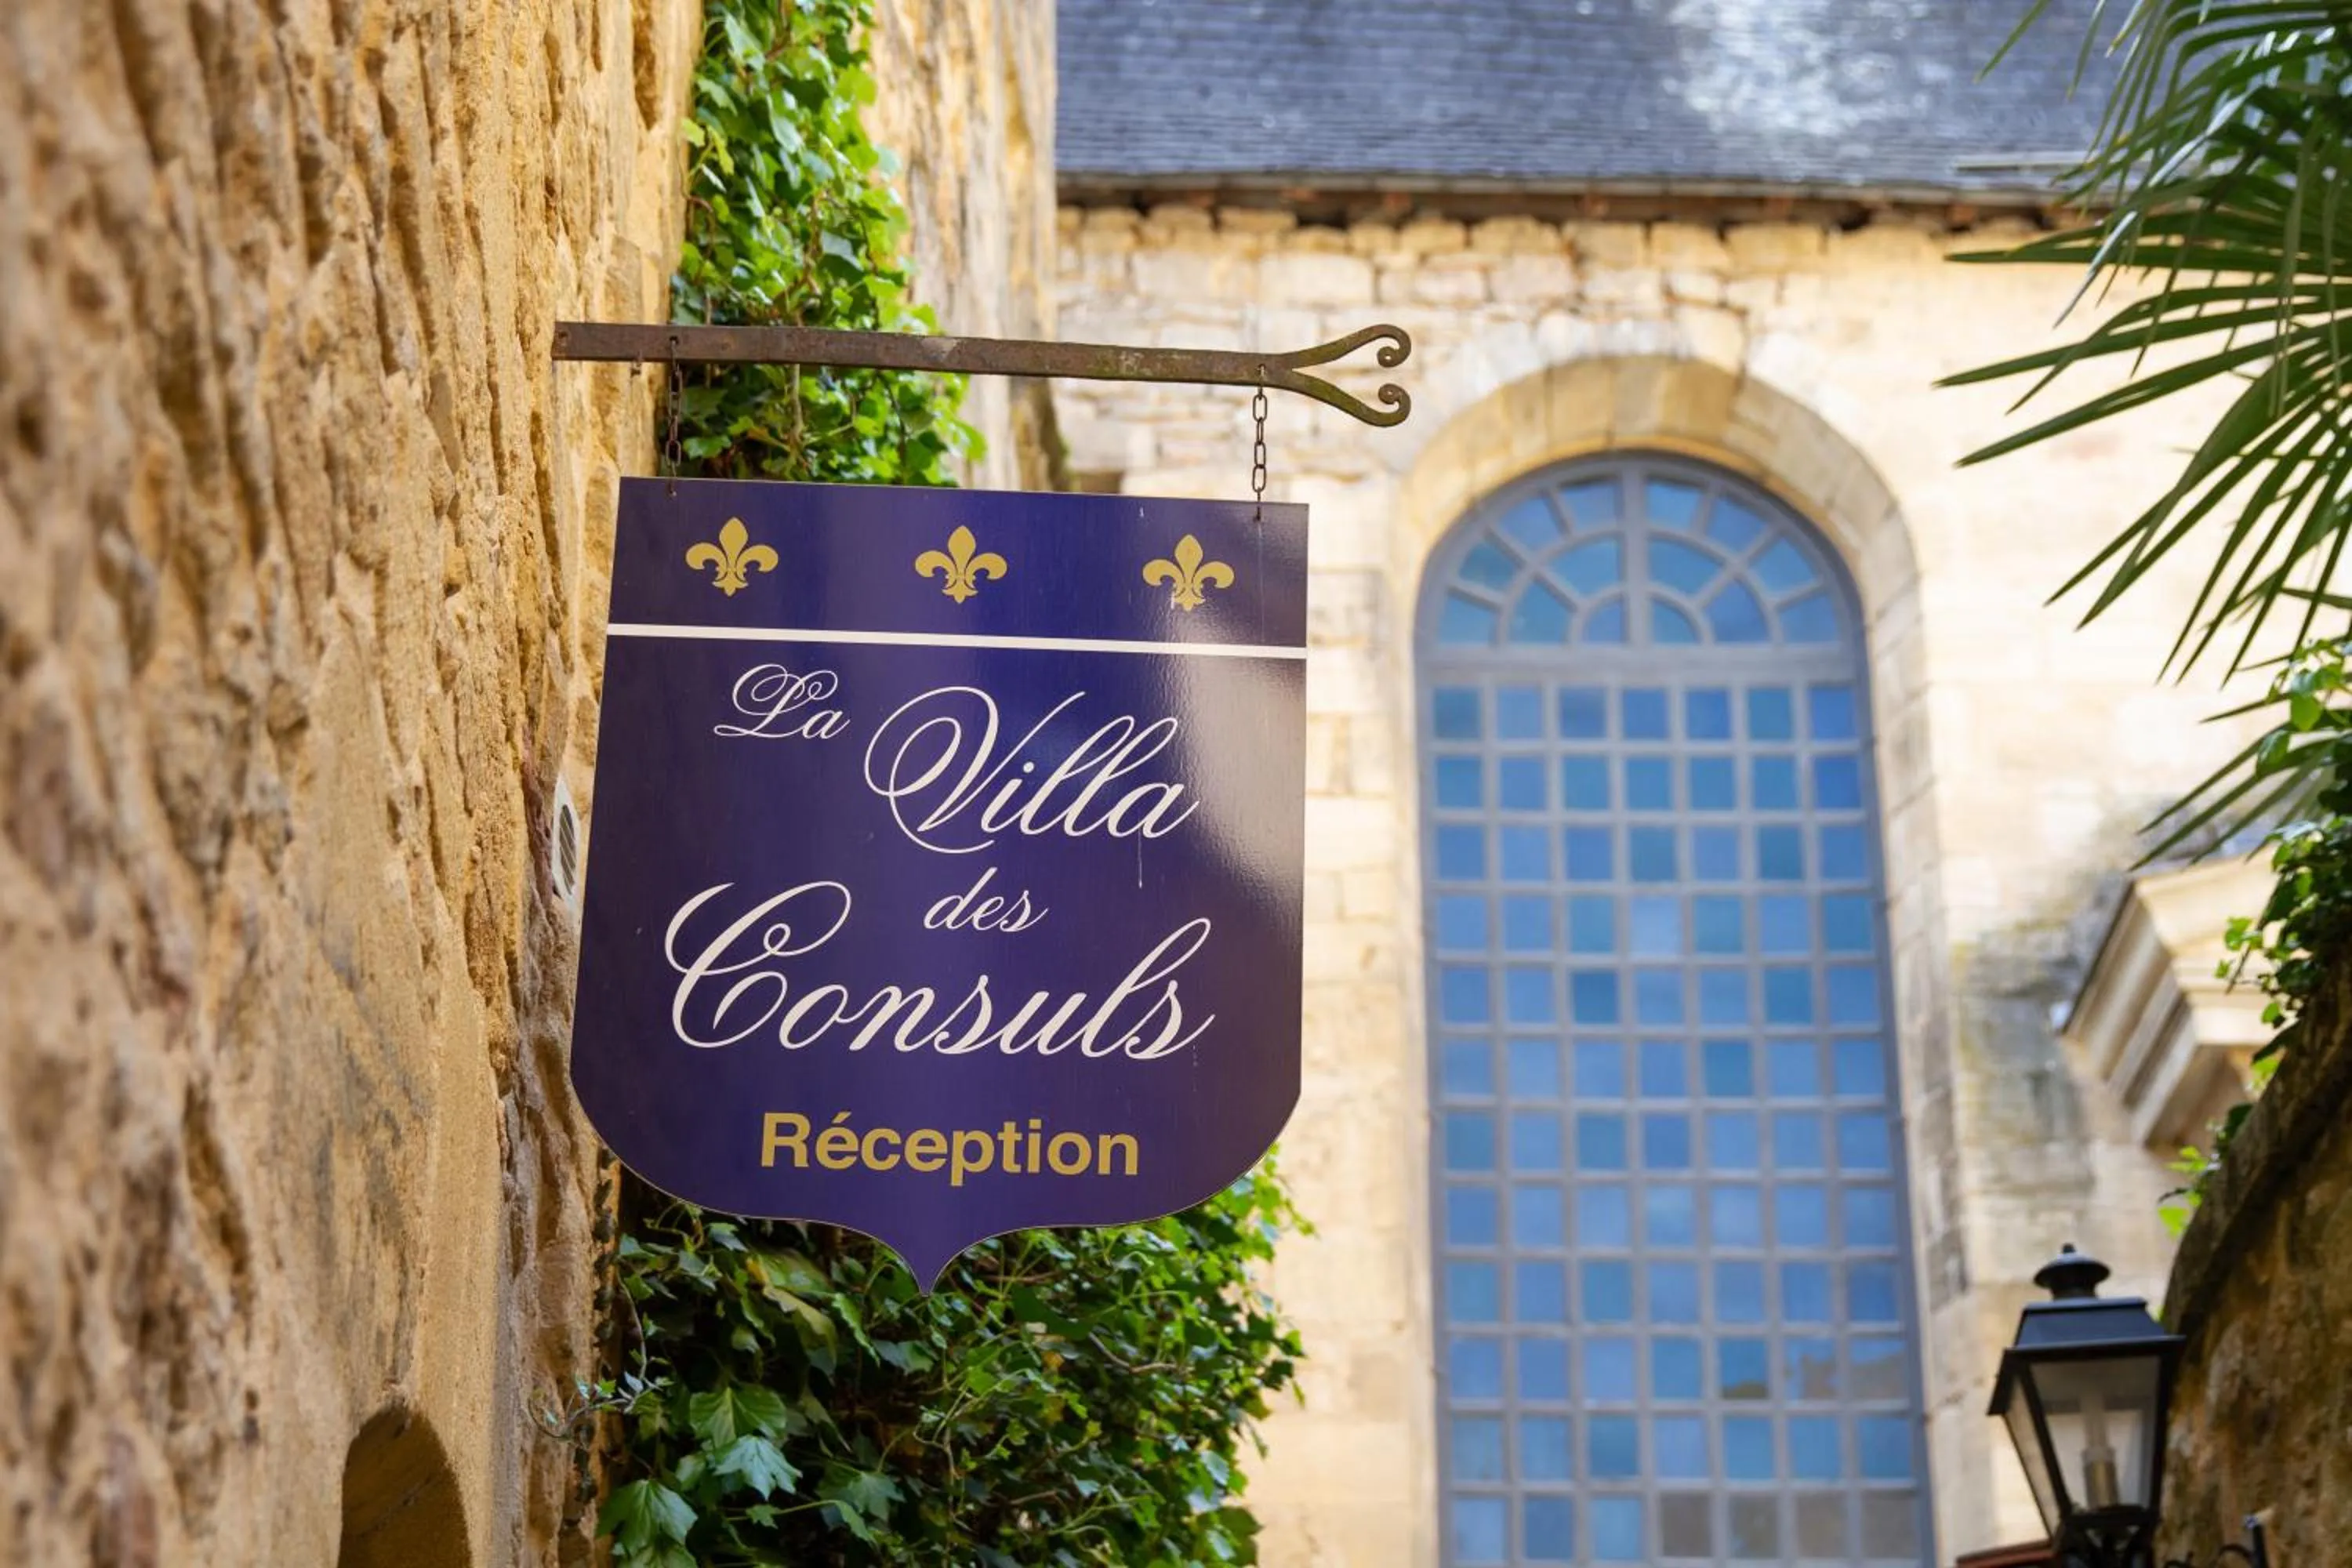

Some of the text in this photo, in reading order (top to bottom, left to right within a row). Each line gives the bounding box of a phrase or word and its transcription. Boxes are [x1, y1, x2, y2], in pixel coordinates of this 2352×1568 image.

[713, 663, 1200, 854] La Villa
[924, 866, 1048, 932] des
[665, 880, 1216, 1060] Consuls
[760, 1110, 1140, 1187] Réception
